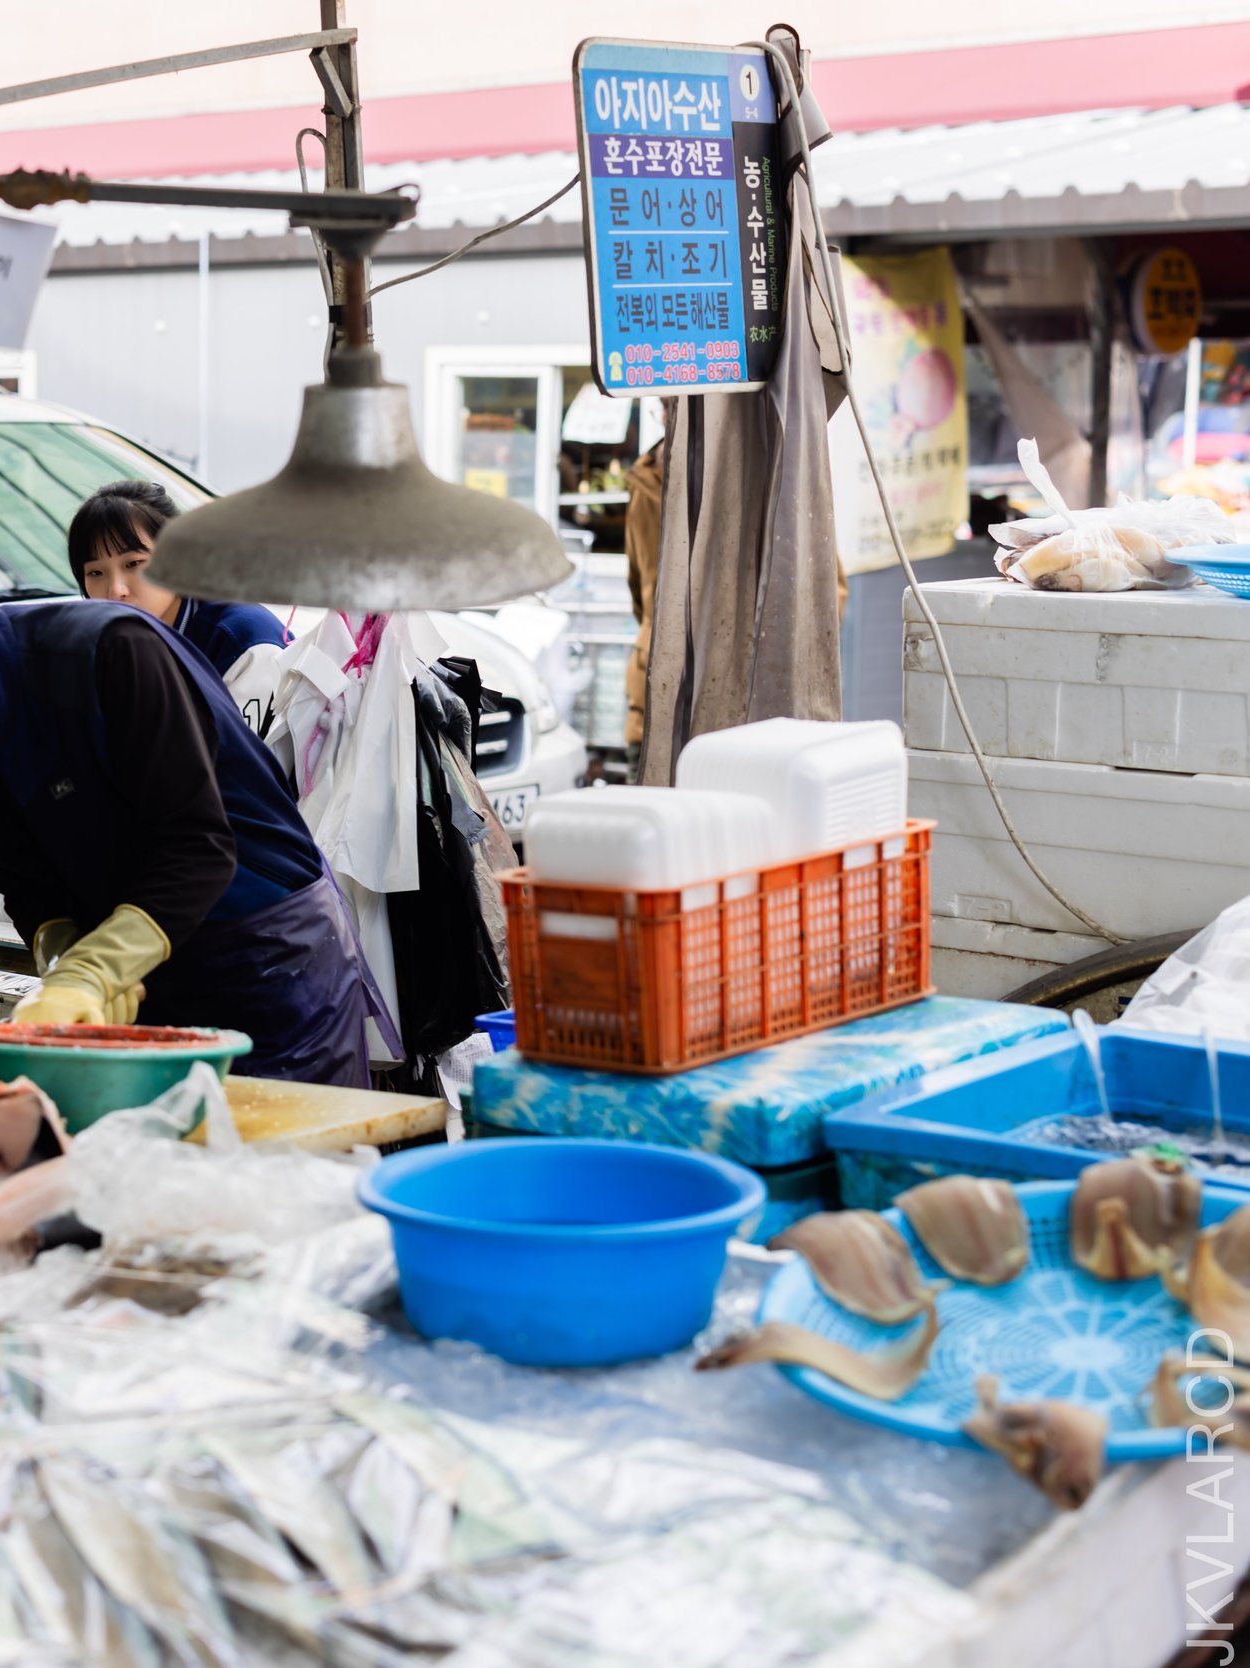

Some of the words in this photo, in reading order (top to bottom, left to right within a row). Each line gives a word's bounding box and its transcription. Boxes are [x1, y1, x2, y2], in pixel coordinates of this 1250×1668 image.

[746, 71, 753, 95] 1
[595, 76, 721, 131] 아지아수산
[603, 137, 724, 177] 혼수포장전문
[762, 156, 773, 214] Agricultural
[767, 229, 777, 264] Marine
[769, 266, 779, 312] Products
[625, 341, 740, 363] 010-2541-0903
[626, 362, 741, 385] 010-4168-8578
